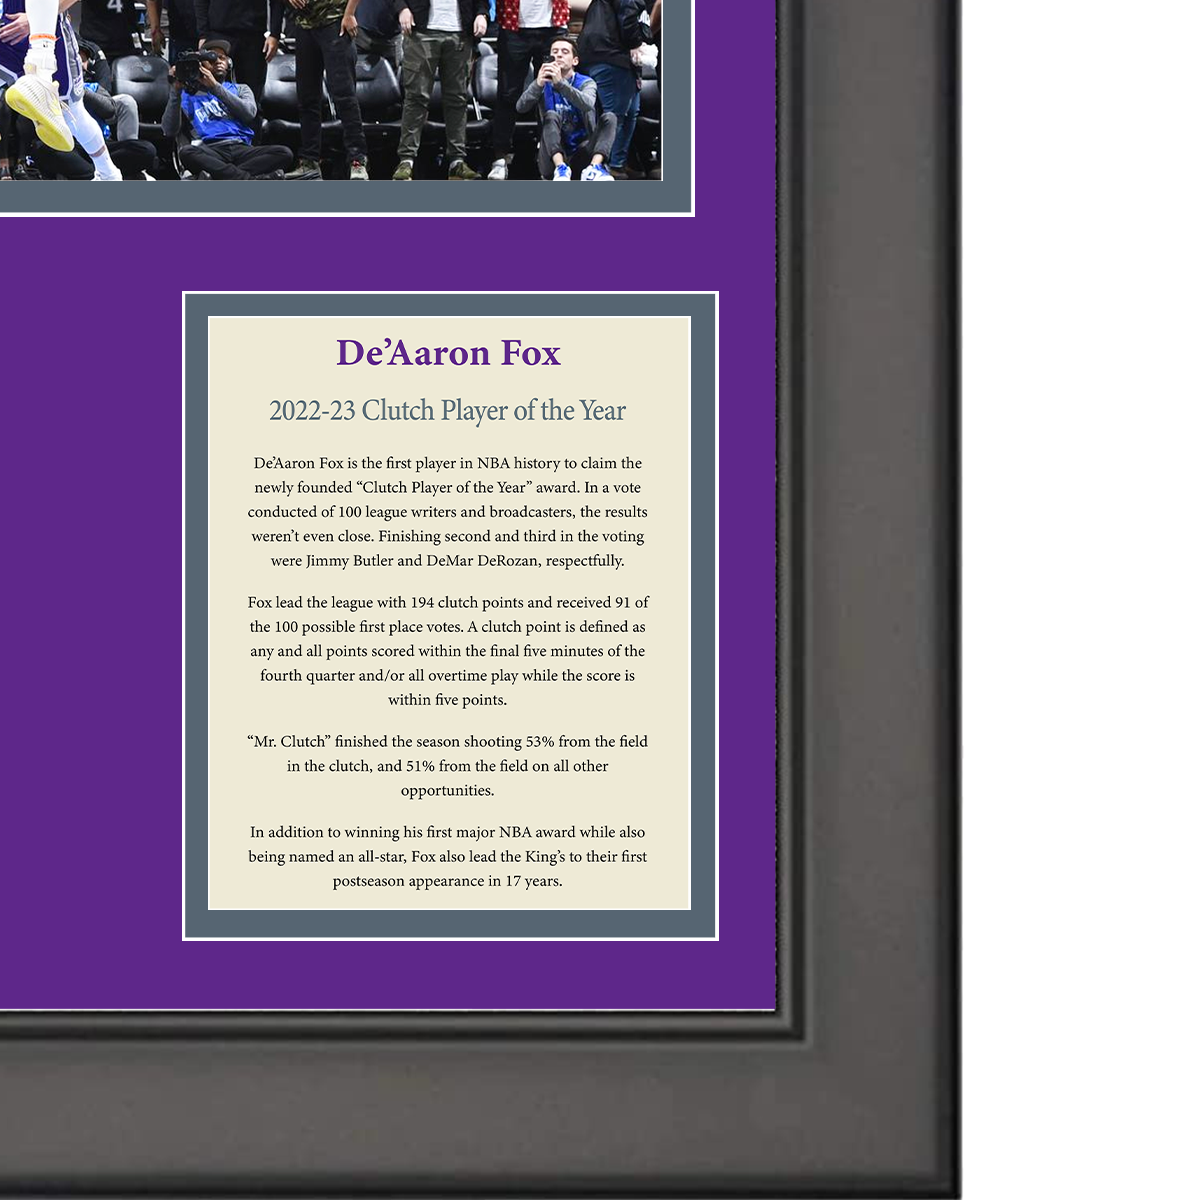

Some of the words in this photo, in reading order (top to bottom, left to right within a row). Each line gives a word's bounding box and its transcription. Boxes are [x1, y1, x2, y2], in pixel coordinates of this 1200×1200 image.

[501, 340, 561, 366] Fox
[270, 400, 355, 420] 2022-23
[362, 398, 435, 420] Clutch
[441, 398, 508, 428] Player
[514, 398, 538, 420] of
[541, 398, 574, 420] the
[579, 400, 626, 420] Year
[320, 457, 344, 469] Fox
[348, 457, 357, 469] is
[361, 456, 382, 469] the
[386, 456, 412, 469] first
[416, 456, 456, 473] player
[460, 457, 473, 469] in
[477, 457, 510, 469] NBA
[514, 456, 561, 472] history
[564, 459, 577, 469] to
[581, 456, 617, 469] claim
[621, 456, 642, 469] the
[255, 481, 294, 497] newly
[298, 480, 352, 493] founded
[412, 481, 452, 498] Player
[456, 480, 471, 493] of
[473, 481, 493, 494] the
[536, 481, 580, 494] award.
[585, 481, 598, 493] In
[603, 485, 609, 494] a
[613, 483, 641, 493] vote
[248, 505, 317, 518] conducted
[321, 505, 336, 518] of
[339, 506, 361, 518] 100
[366, 505, 407, 522] league
[411, 506, 456, 518] writers
[461, 505, 485, 517] and
[490, 505, 575, 519] broadcasters,
[580, 505, 601, 517] the
[605, 505, 647, 518] results
[303, 533, 334, 542] even
[338, 529, 374, 542] close.
[379, 530, 441, 546] Finishing
[445, 529, 491, 542] second
[495, 529, 519, 542] and
[524, 529, 556, 542] third
[561, 530, 573, 542] in
[578, 529, 598, 542] the
[602, 530, 644, 546] voting
[271, 558, 302, 567] were
[306, 555, 349, 570] Jimmy
[353, 554, 394, 567] Butler
[398, 554, 422, 566] and
[427, 555, 473, 567] DeMar
[478, 555, 541, 568] DeRozan,
[546, 554, 624, 570] respectfully.
[248, 596, 272, 608] Fox
[276, 596, 303, 608] lead
[307, 596, 327, 608] the
[331, 596, 373, 612] league
[377, 596, 406, 608] with
[412, 597, 434, 608] 194
[438, 596, 478, 608] clutch
[482, 597, 523, 612] points
[528, 596, 552, 608] and
[557, 596, 611, 608] received
[616, 597, 630, 608] 91
[635, 595, 650, 608] of
[335, 735, 388, 748] finished
[392, 735, 412, 748] the
[417, 739, 460, 748] season
[464, 735, 522, 751] shooting
[526, 736, 554, 747] 53%
[559, 735, 591, 748] from
[595, 735, 615, 748] the
[620, 735, 648, 748] field
[333, 876, 404, 890] postseason
[409, 878, 484, 890] appearance
[489, 875, 501, 886] in
[507, 875, 521, 886] 17
[525, 878, 562, 890] years.
